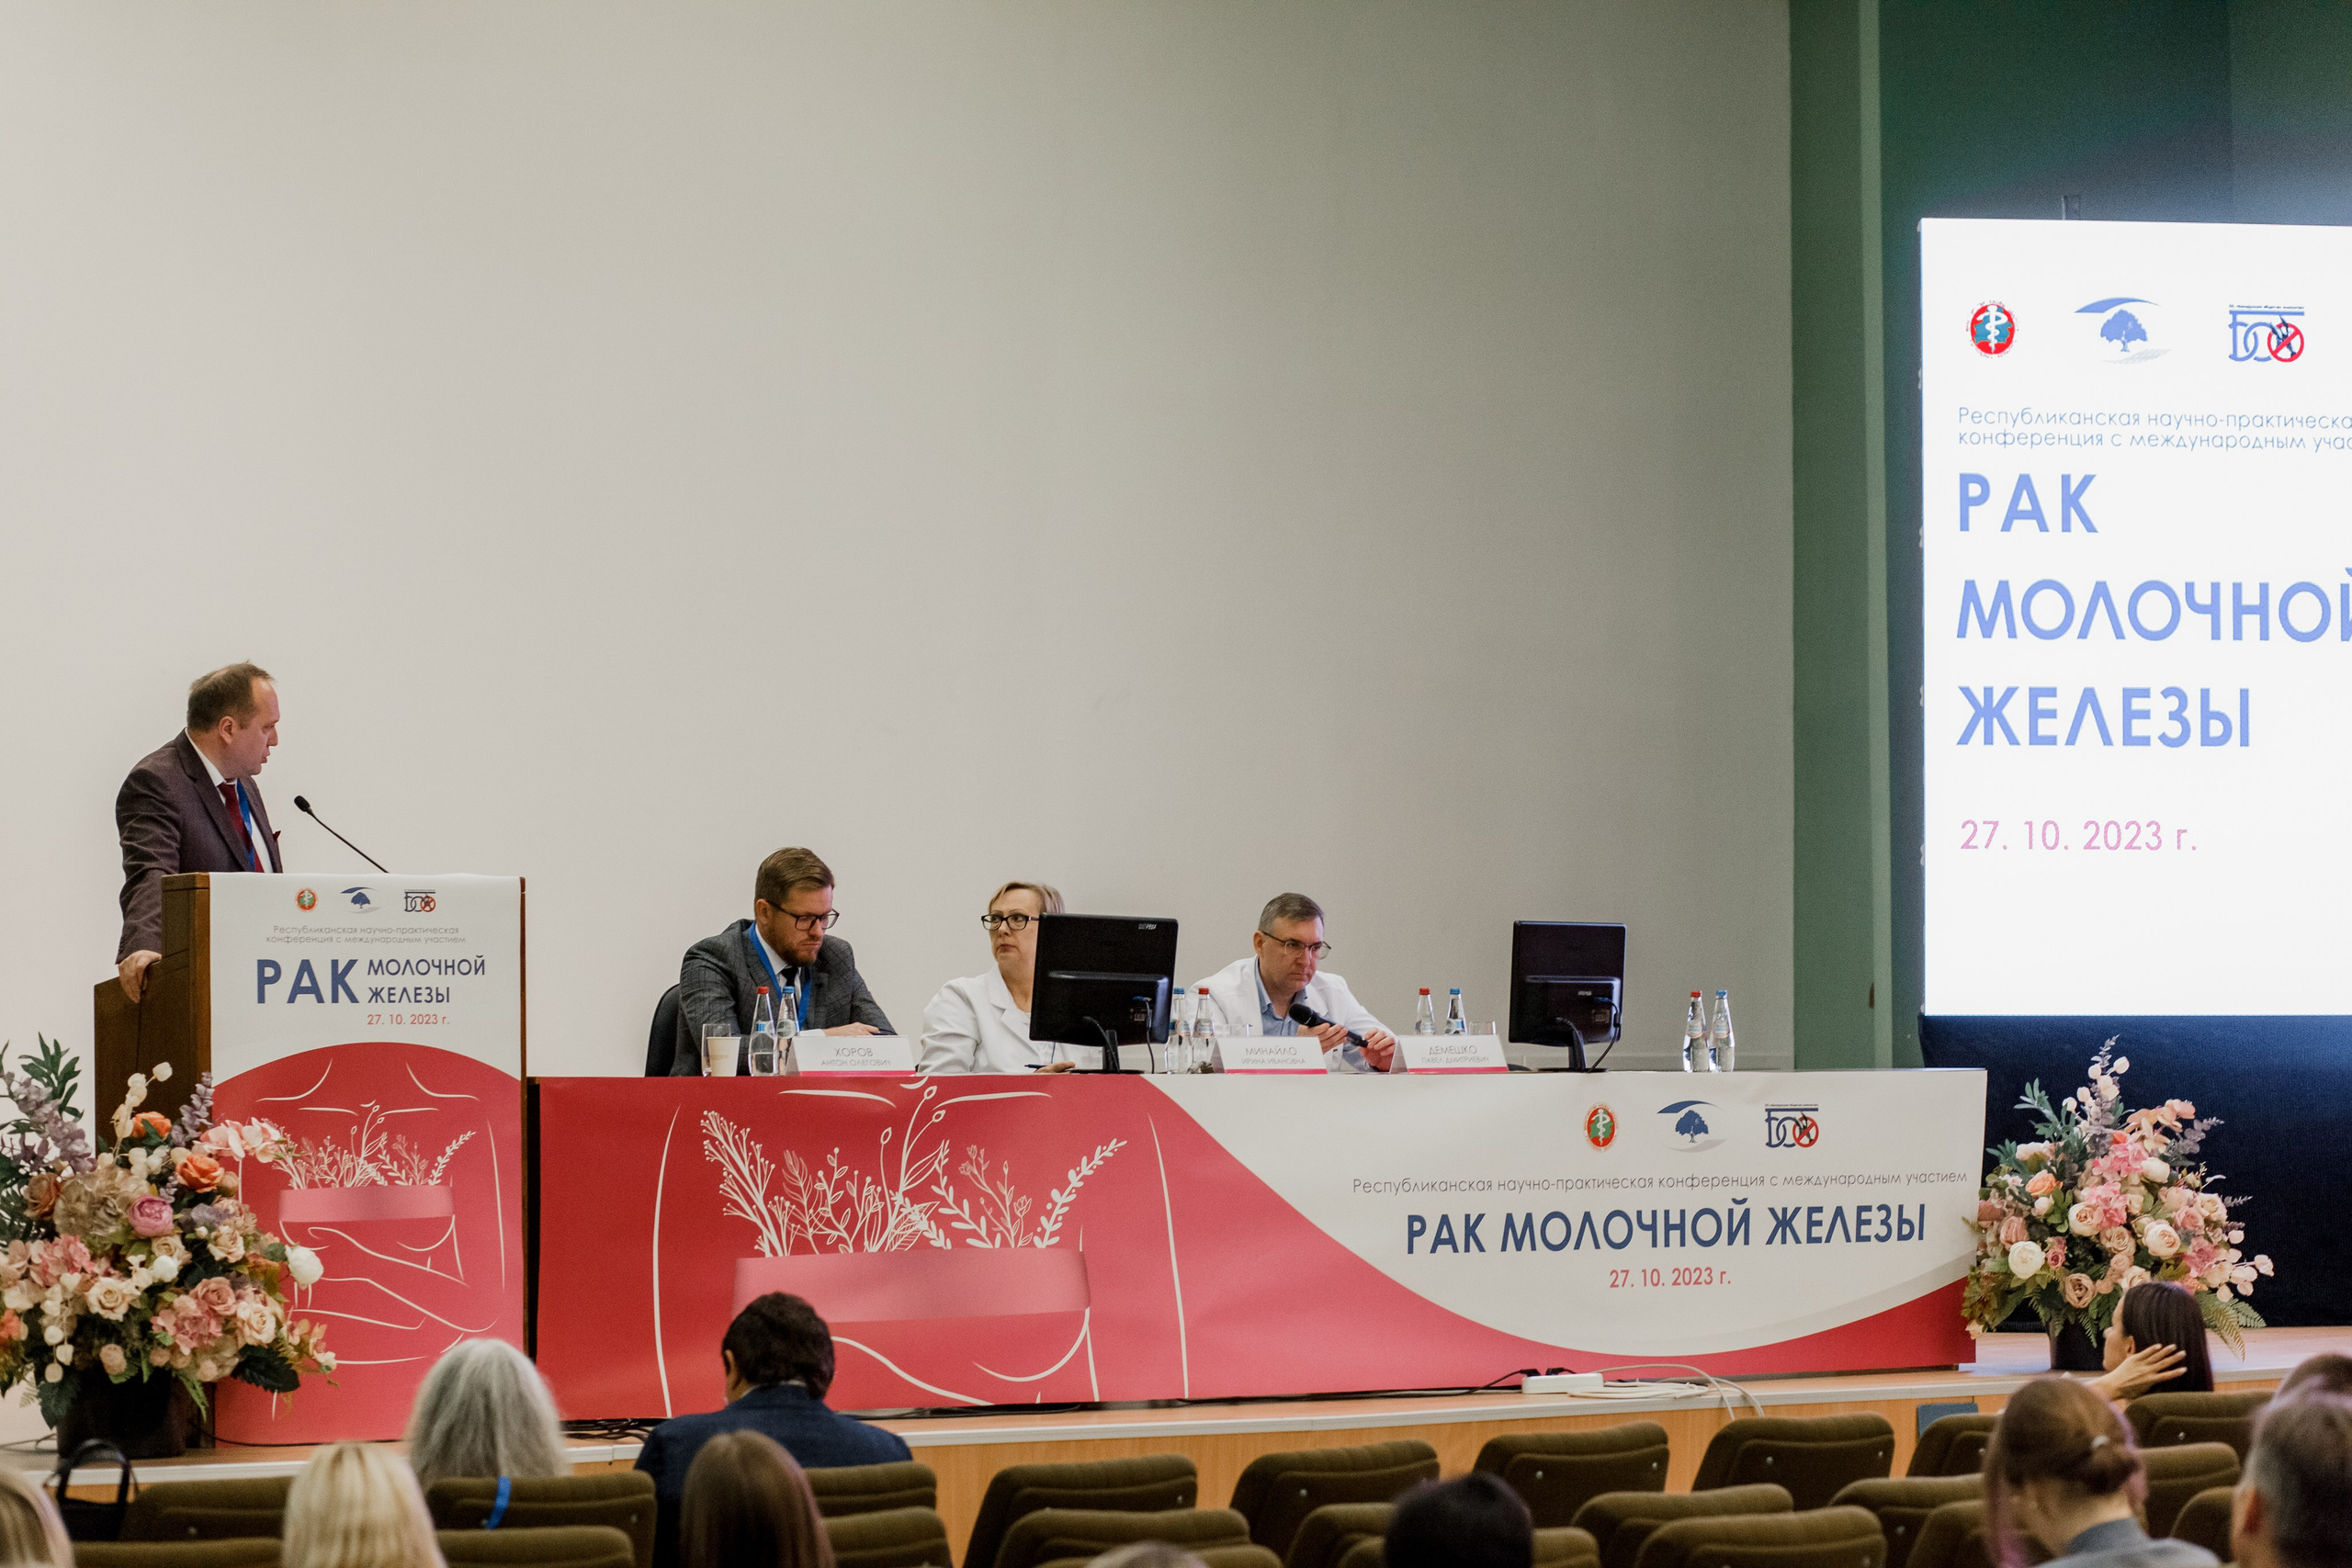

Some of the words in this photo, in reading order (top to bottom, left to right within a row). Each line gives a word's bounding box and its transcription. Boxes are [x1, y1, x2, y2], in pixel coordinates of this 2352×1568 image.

[1958, 407, 2140, 428] Республиканская
[1958, 428, 2103, 448] конференция
[2111, 432, 2122, 447] с
[2130, 432, 2306, 452] международным
[1958, 472, 2098, 533] РАК
[1956, 685, 2250, 749] ЖЕЛЕЗЫ
[1961, 819, 2008, 851] 27.
[2023, 819, 2069, 851] 10.
[2082, 819, 2164, 851] 2023
[2176, 829, 2198, 852] г.
[266, 935, 334, 944] конференция
[345, 936, 422, 944] международным
[424, 936, 467, 944] участием
[273, 925, 357, 935] Республиканская
[360, 927, 459, 935] научно-практическая
[256, 959, 360, 1004] РАК
[368, 954, 486, 976] МОЛОЧНОЙ
[368, 987, 450, 1004] ЖЕЛЕЗЫ
[367, 1014, 385, 1025] 27.
[390, 1014, 406, 1025] 10.
[410, 1014, 438, 1025] 2023
[442, 1016, 450, 1025] г.
[834, 1047, 874, 1057] ХОРОВ
[1352, 1178, 1492, 1195] Республиканская
[1498, 1177, 1654, 1194] научно-практическая
[1658, 1174, 1765, 1190] конференция
[1770, 1176, 1778, 1186] с
[1782, 1173, 1902, 1190] международным
[1905, 1171, 1968, 1186] участием
[1408, 1213, 1487, 1254] РАК
[1500, 1198, 1750, 1252] МОЛОЧНОЙ
[1765, 1203, 1926, 1245] ЖЕЛЕЗЫ
[1609, 1269, 1634, 1288] 27.
[1640, 1269, 1665, 1287] 10.
[1671, 1267, 1713, 1286] 2023
[1719, 1270, 1732, 1285] г.
